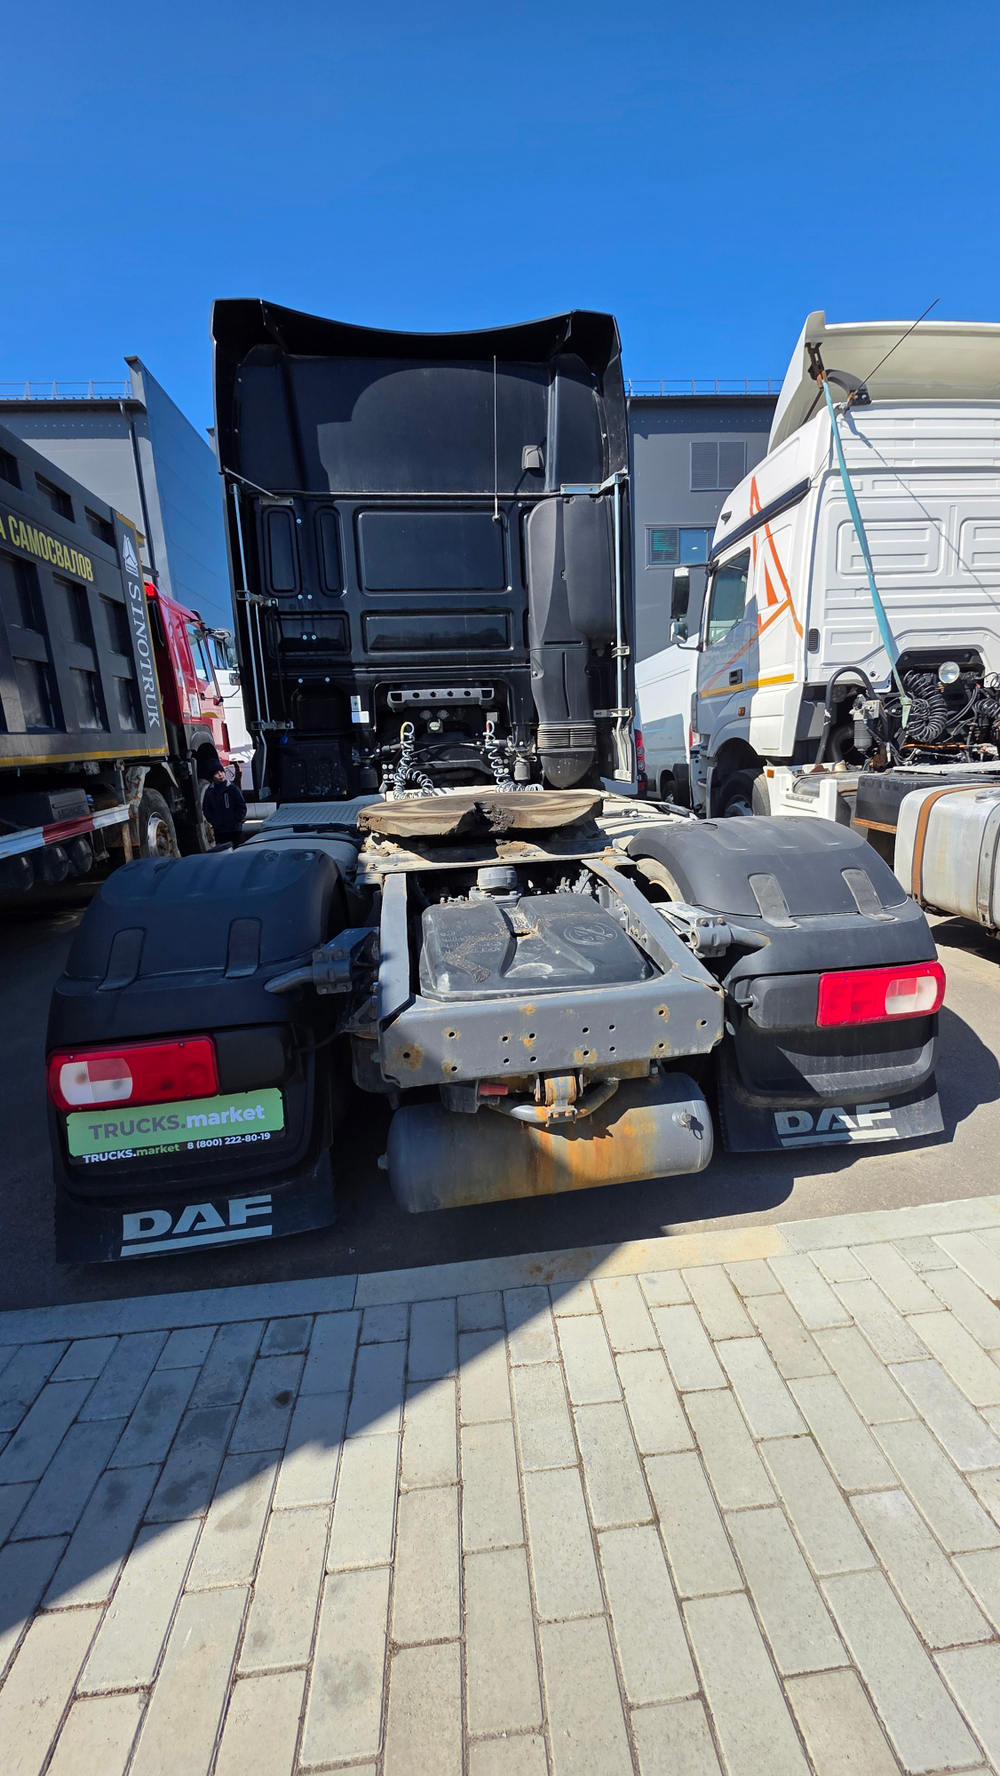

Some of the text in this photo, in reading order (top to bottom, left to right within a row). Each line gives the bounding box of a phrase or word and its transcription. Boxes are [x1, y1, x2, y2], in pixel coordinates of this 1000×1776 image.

[8, 515, 94, 582] САМОСВАЛОВ
[128, 581, 161, 727] SINOTRUK
[89, 1104, 266, 1140] TRUCKS.market
[774, 1101, 892, 1135] DAF
[83, 1131, 271, 1164] TRUCKS.market 8 (800) 222-80-19
[122, 1194, 273, 1241] DAF
